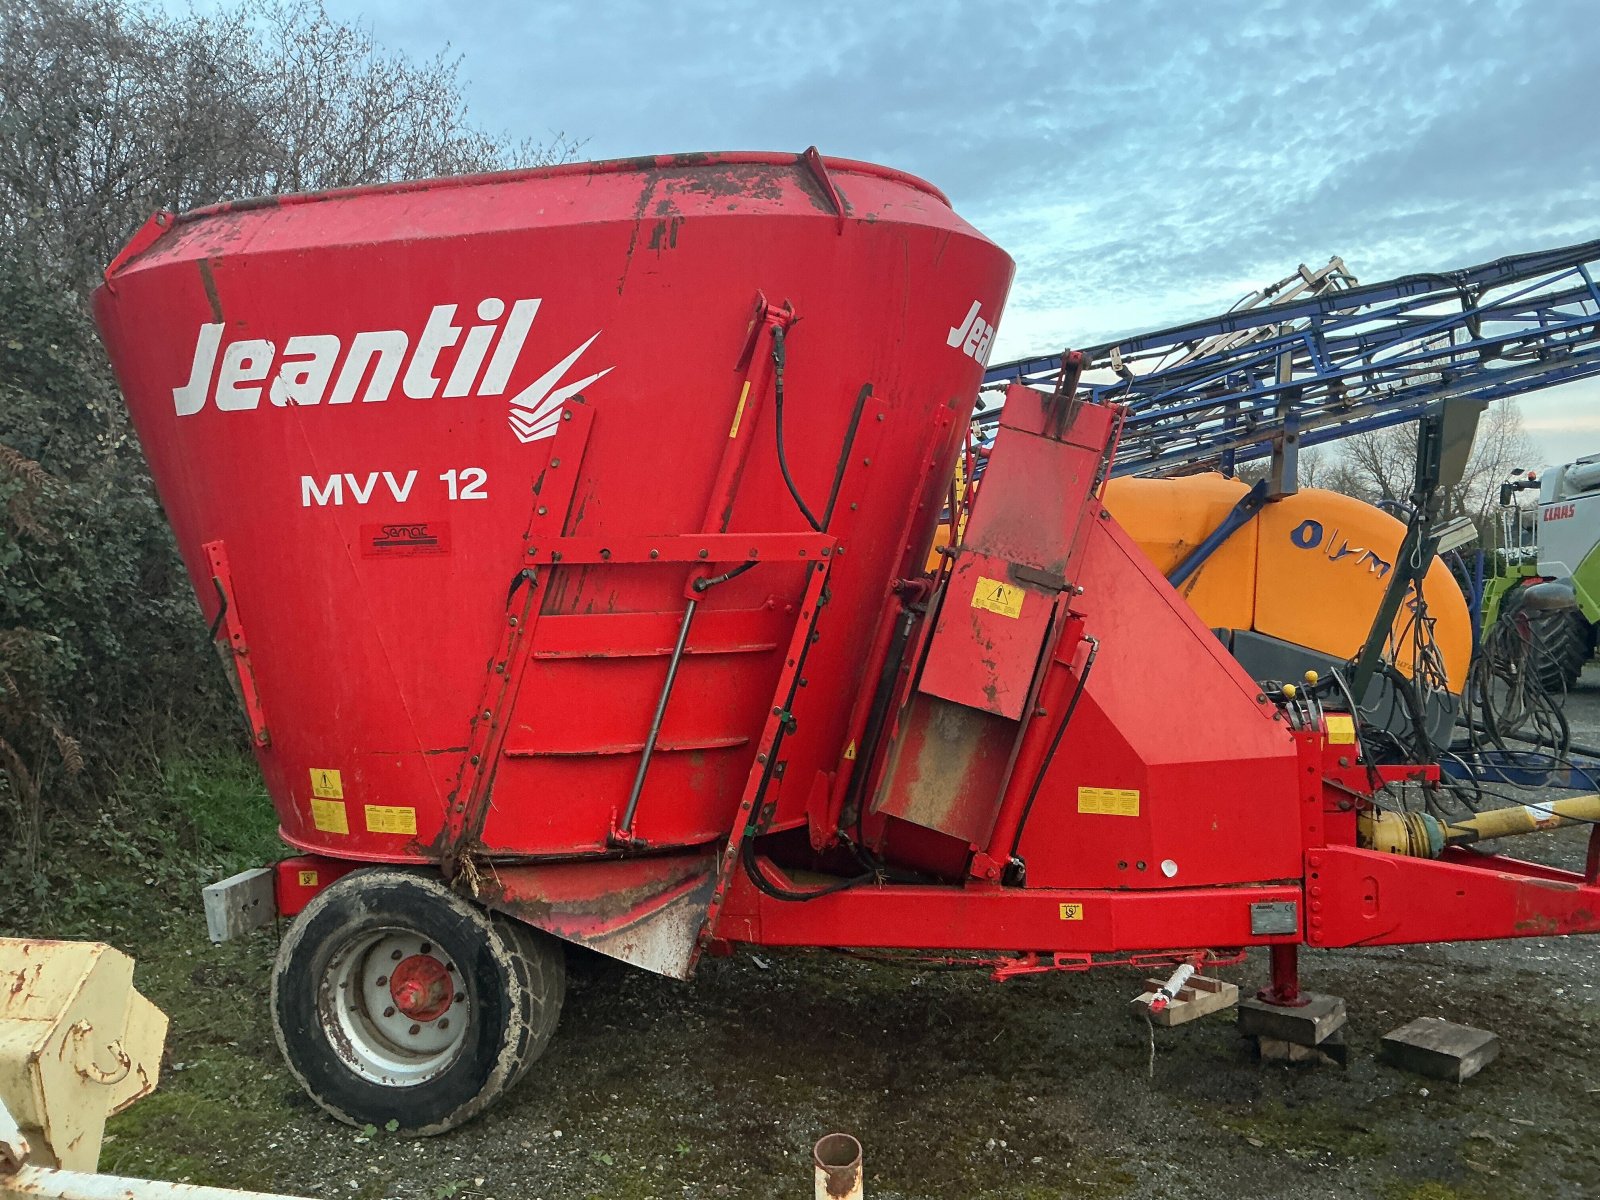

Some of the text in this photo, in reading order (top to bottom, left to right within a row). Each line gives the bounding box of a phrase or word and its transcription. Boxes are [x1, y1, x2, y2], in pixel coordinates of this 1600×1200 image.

[172, 297, 542, 416] Jeantil
[301, 467, 488, 507] MVV 12
[1543, 504, 1576, 521] CLAAS
